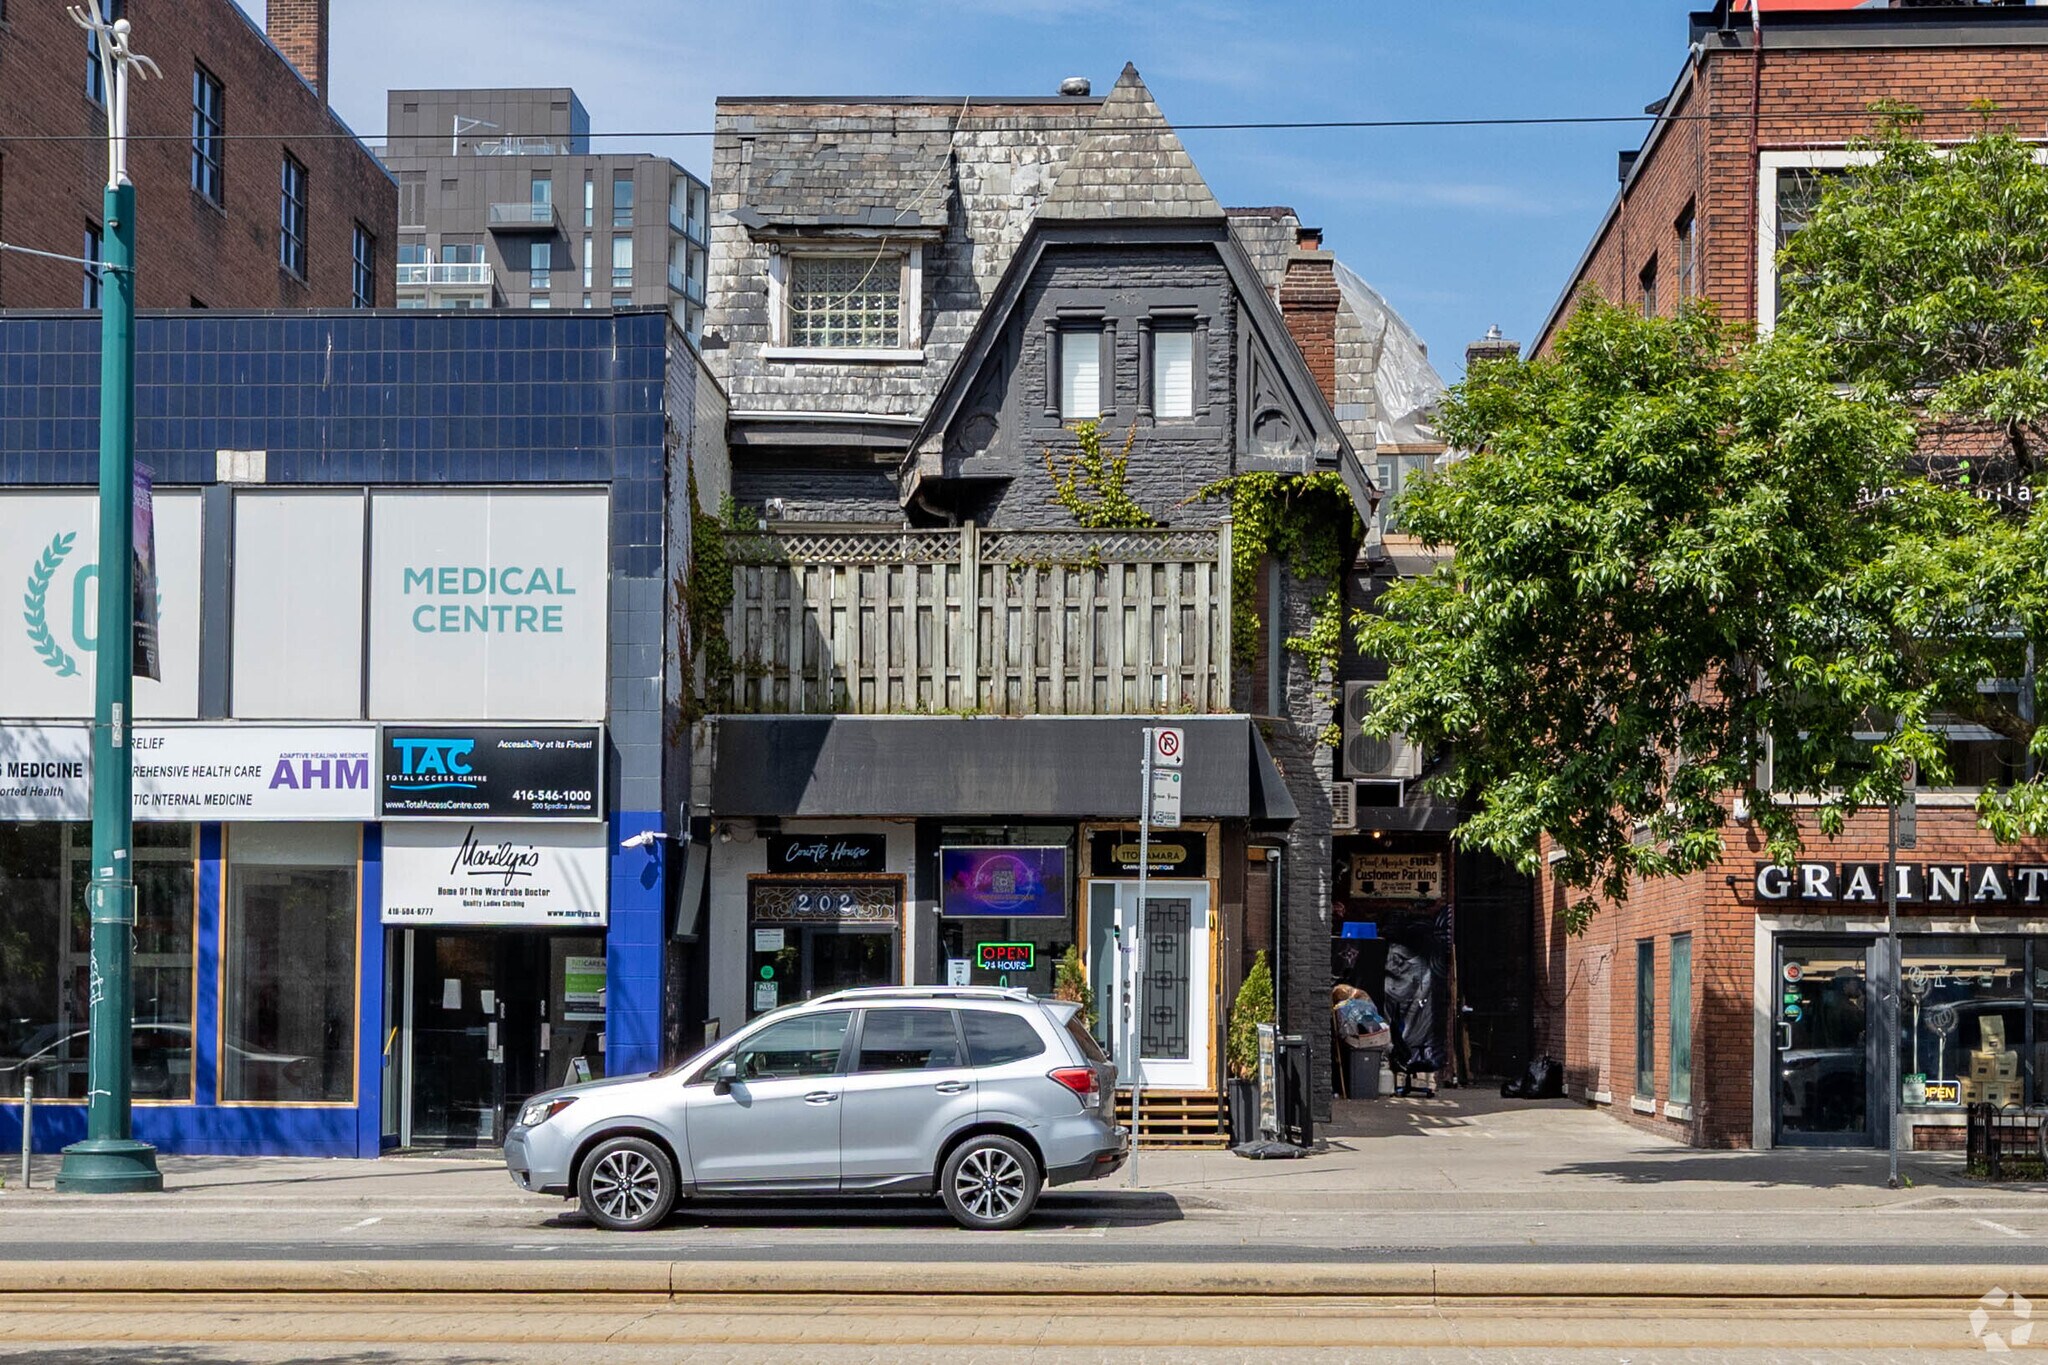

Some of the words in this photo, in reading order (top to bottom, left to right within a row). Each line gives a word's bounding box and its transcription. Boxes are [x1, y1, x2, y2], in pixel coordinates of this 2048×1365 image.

[403, 567, 576, 595] MEDICAL
[412, 604, 564, 633] CENTRE
[555, 740, 565, 748] its
[566, 740, 592, 749] Finest!
[393, 738, 474, 774] TAC
[8, 763, 83, 778] MEDICINE
[133, 766, 189, 777] REHENSIVE
[192, 766, 231, 777] HEALTH
[234, 766, 262, 777] CARE
[268, 760, 369, 789] AHM
[30, 786, 64, 797] Health
[512, 790, 591, 801] 416-546-1000
[134, 794, 149, 806] TIC
[152, 794, 201, 806] INTERNAL
[204, 794, 253, 806] MEDICINE
[385, 800, 490, 809] www.TotalAccessCentre.com
[544, 803, 567, 811] Spadina
[1122, 851, 1180, 860] ITOAMARA
[1355, 868, 1400, 880] Customer
[1402, 868, 1437, 883] Parking
[1756, 864, 2048, 902] GRAINAT
[438, 887, 457, 896] Home
[460, 887, 468, 896] Of
[470, 887, 483, 896] The
[525, 888, 551, 897] Doctor
[799, 894, 851, 912] 202
[983, 947, 1029, 960] OPEN
